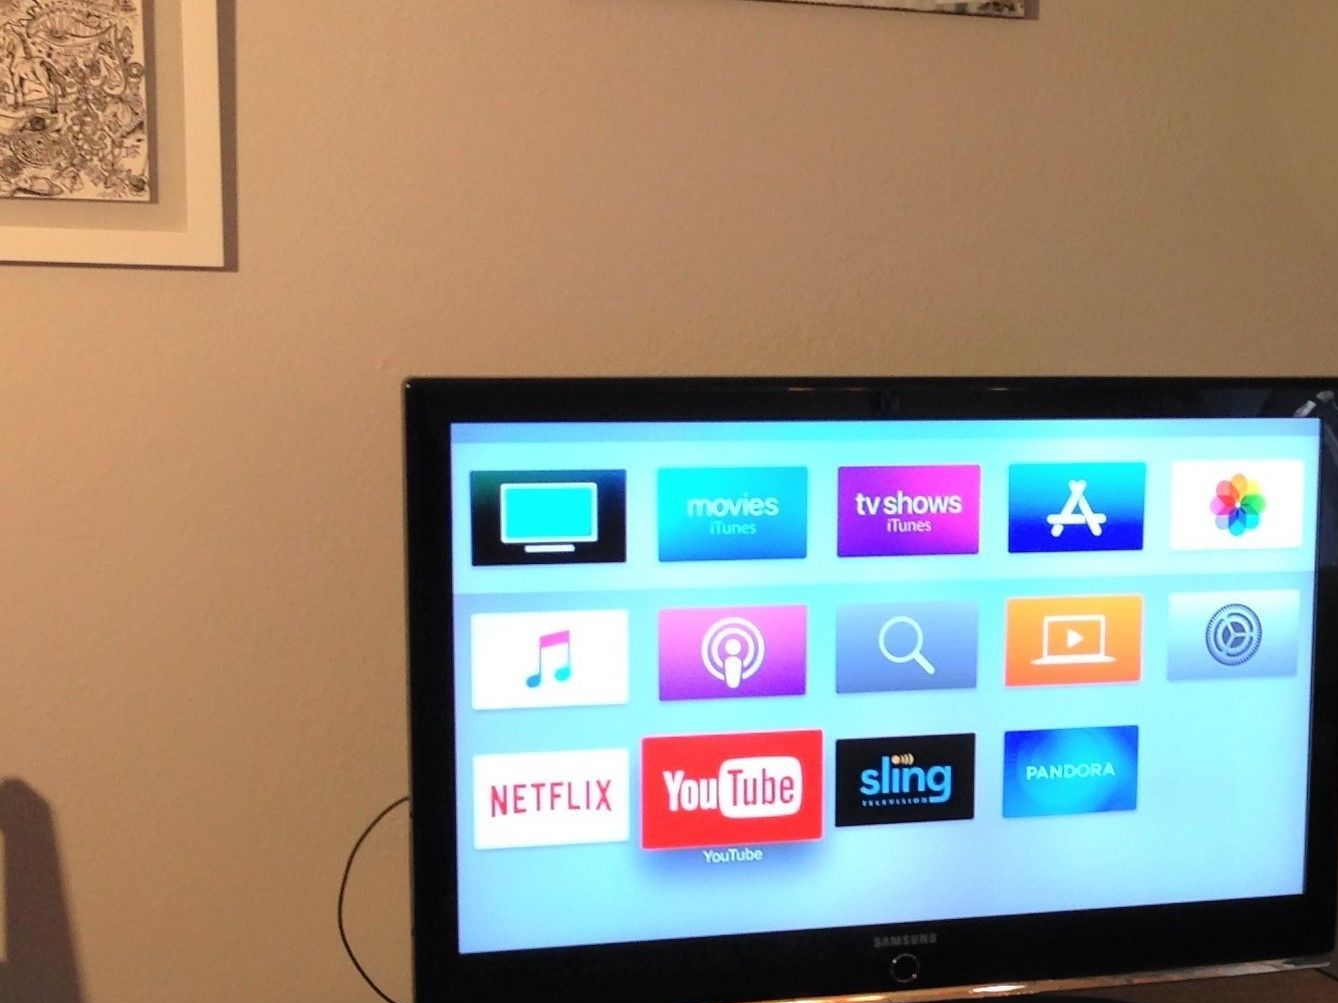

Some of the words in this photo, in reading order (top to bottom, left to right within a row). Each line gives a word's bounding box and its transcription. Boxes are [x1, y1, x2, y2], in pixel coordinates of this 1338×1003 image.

[687, 491, 780, 517] movies
[855, 492, 880, 516] tv
[882, 490, 964, 515] shows
[709, 520, 757, 536] iTunes
[886, 517, 933, 533] iTunes
[860, 754, 952, 803] sling
[1025, 761, 1117, 782] PANDORA
[490, 780, 613, 818] NETFLIX
[662, 763, 800, 814] YouTube
[702, 846, 764, 864] YouTube
[873, 932, 938, 949] SAMSUNG
